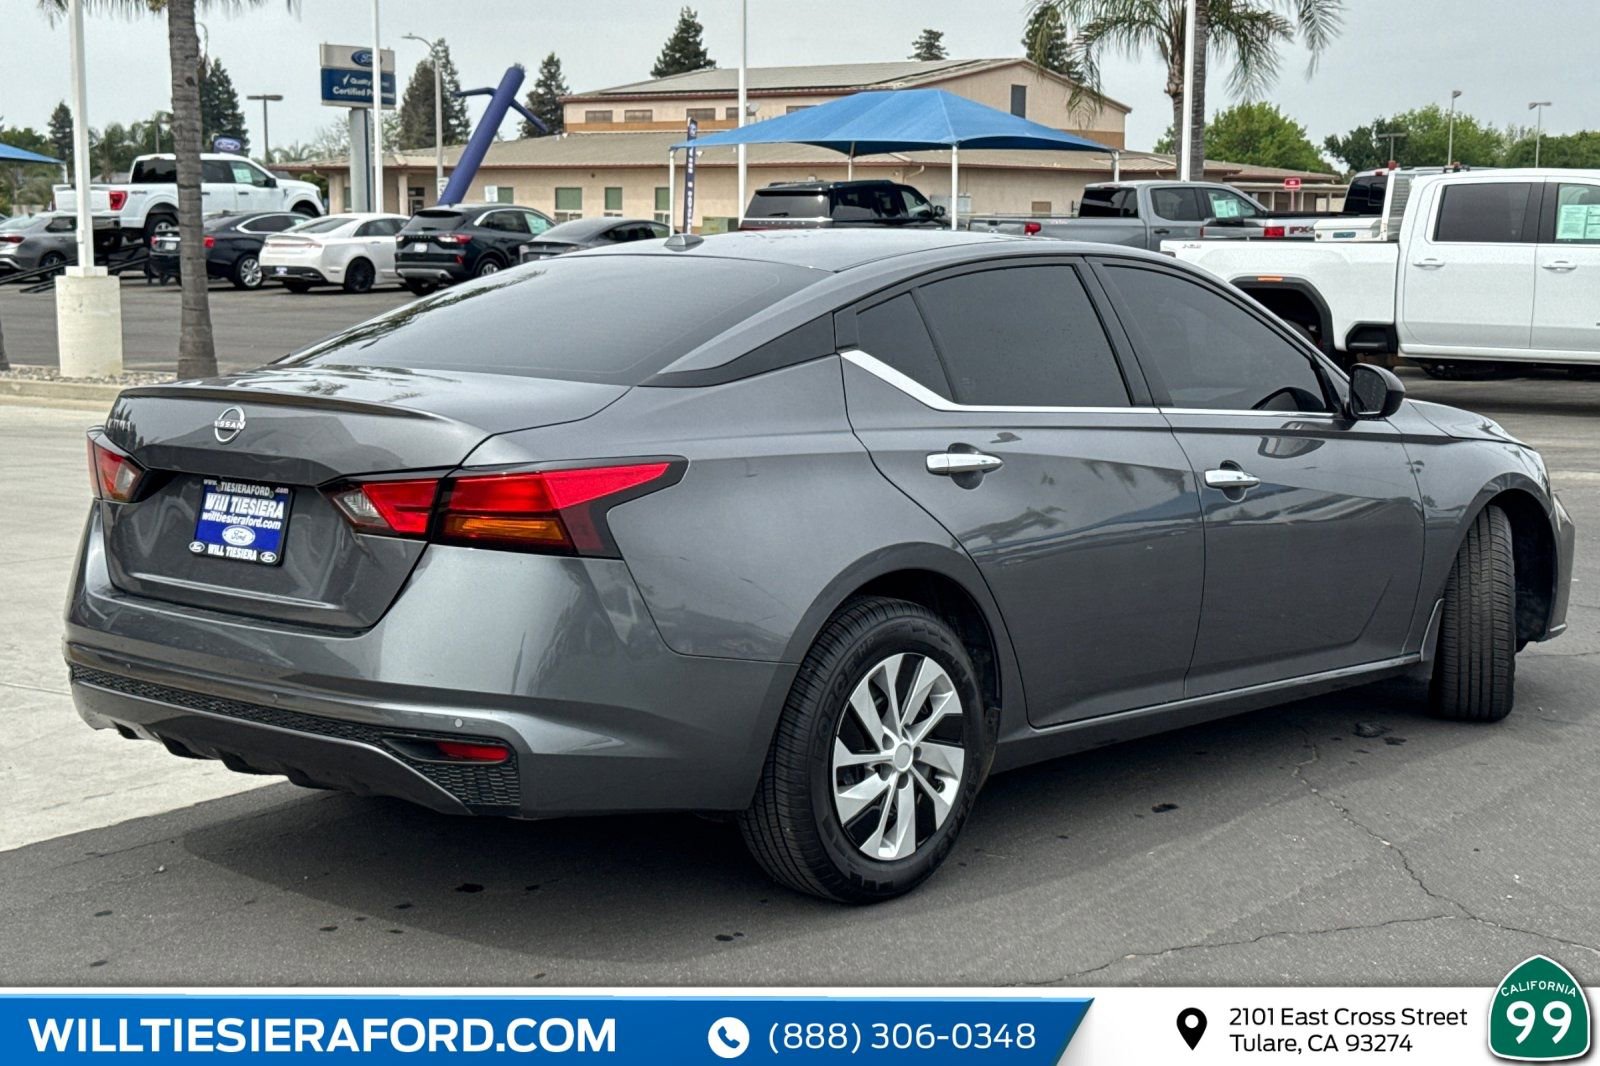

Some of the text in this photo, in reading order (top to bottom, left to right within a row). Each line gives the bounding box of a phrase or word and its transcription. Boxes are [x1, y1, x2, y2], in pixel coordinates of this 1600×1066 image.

[332, 86, 366, 97] Certified
[220, 481, 271, 496] TIESIERAFORD
[230, 496, 284, 519] TIESIERA
[201, 511, 282, 530] willtiesieraford.com
[207, 543, 225, 557] WILL
[226, 546, 258, 561] TIESIERA
